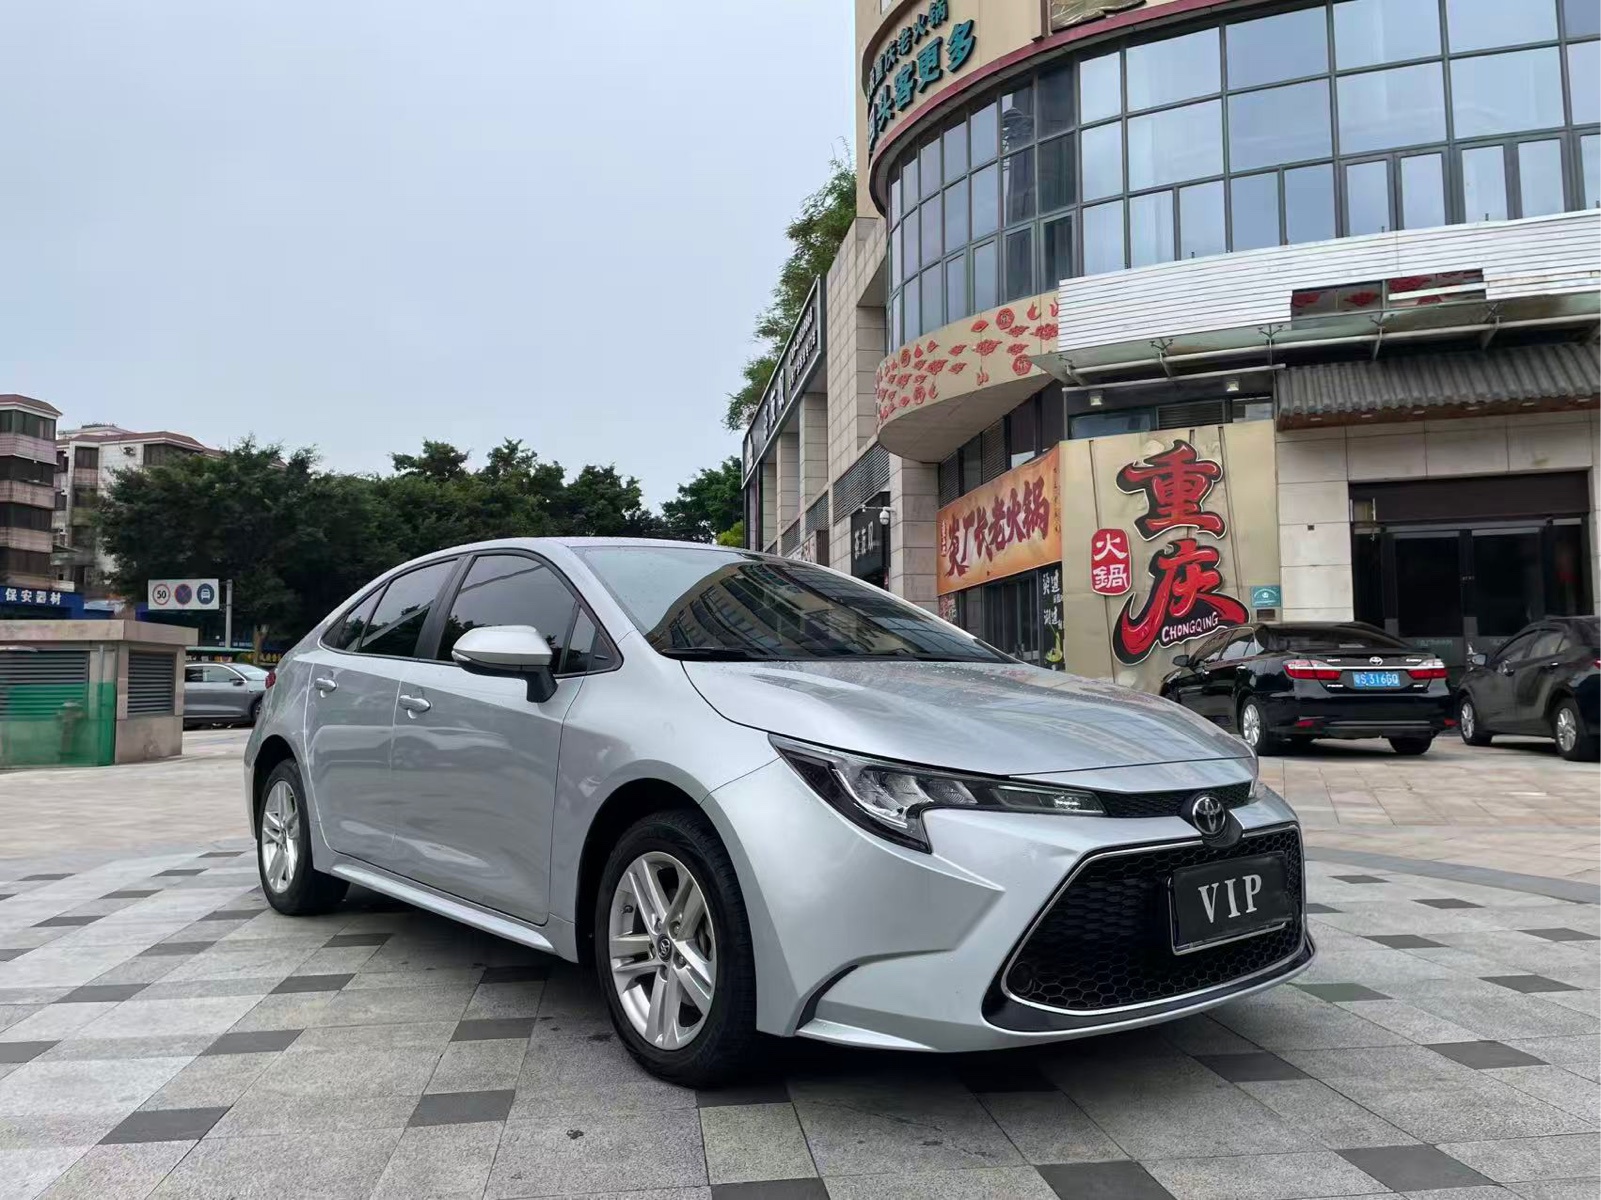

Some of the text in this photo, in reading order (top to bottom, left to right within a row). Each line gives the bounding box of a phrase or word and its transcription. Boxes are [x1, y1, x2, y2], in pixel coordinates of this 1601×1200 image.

[1113, 439, 1250, 666] 重庆
[5, 588, 61, 605] 保安器材
[156, 589, 167, 600] 50
[1161, 611, 1219, 643] CHONGQING
[1198, 874, 1262, 923] VIP
